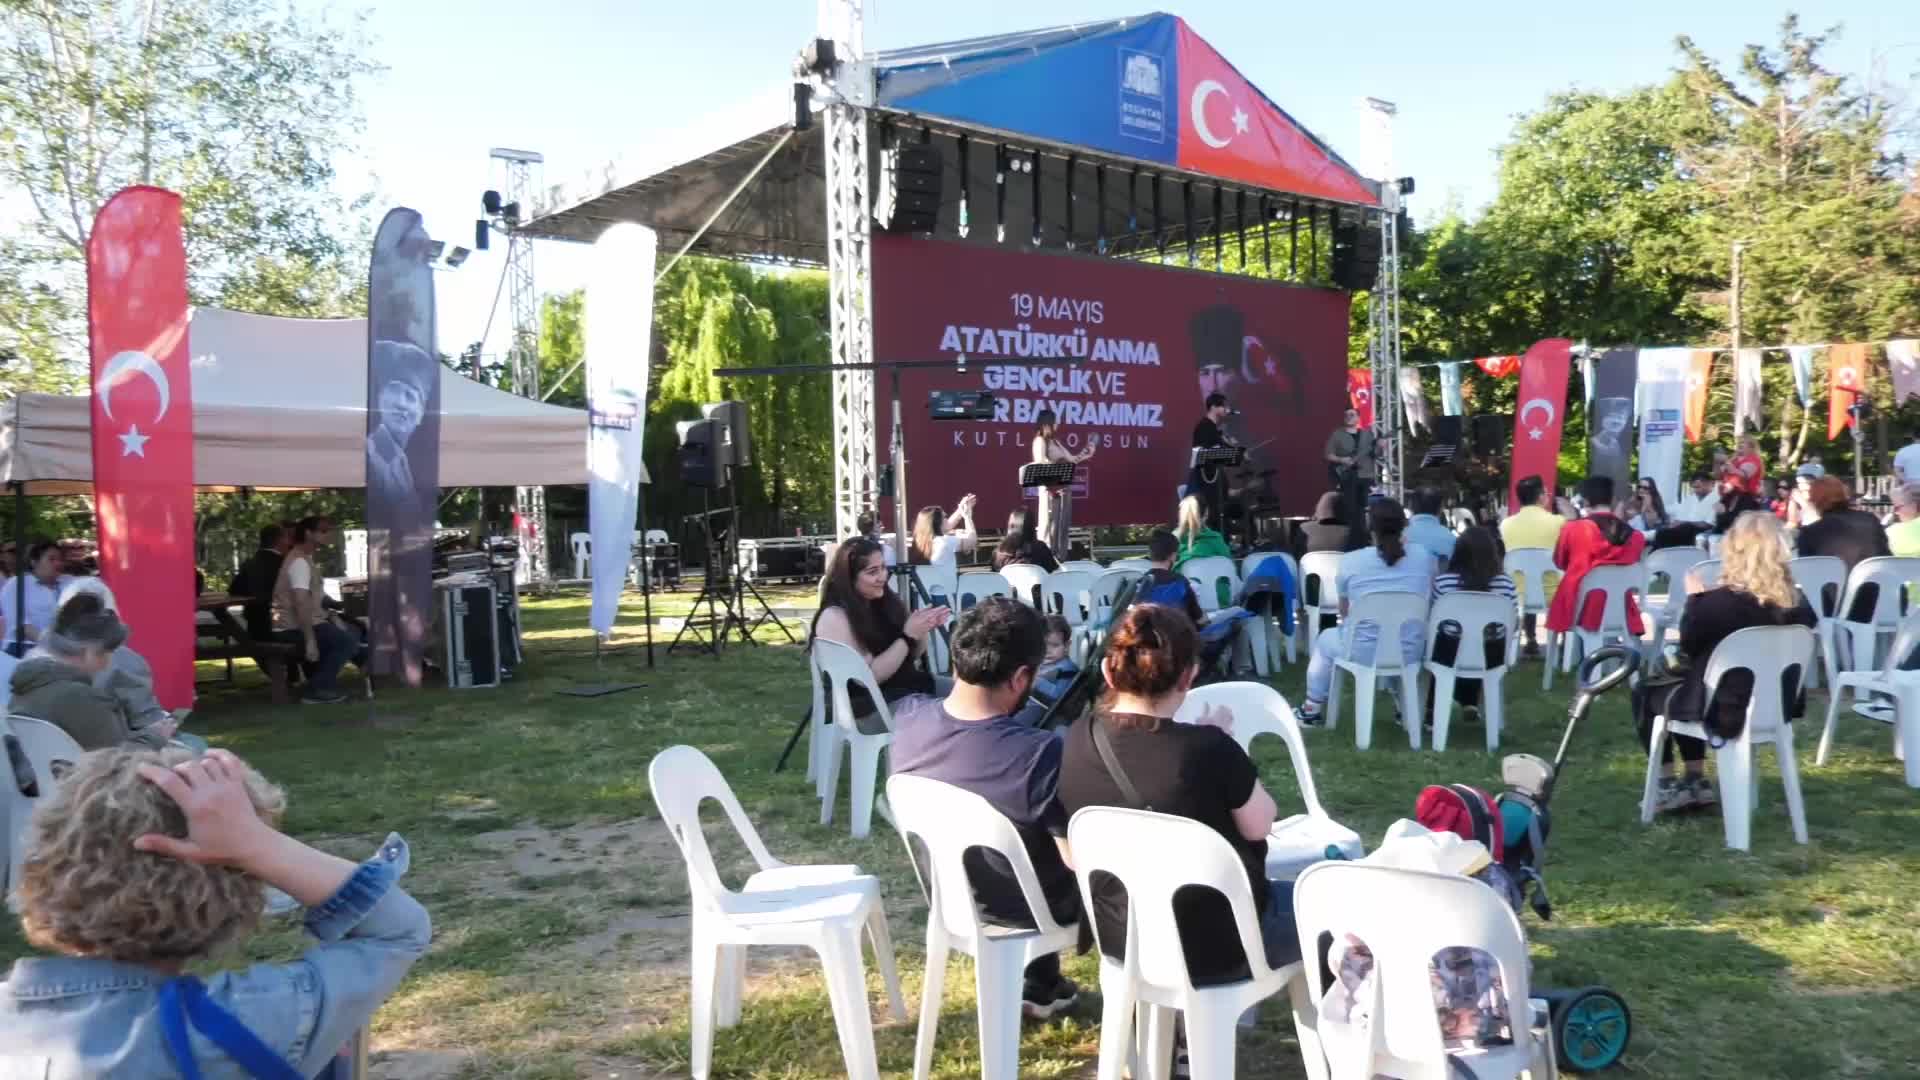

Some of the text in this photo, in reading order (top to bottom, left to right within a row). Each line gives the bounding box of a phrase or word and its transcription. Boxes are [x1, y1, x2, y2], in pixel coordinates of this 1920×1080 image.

[1009, 293, 1104, 323] 19 MAYIS
[940, 323, 1161, 365] ATATÜRK'Ü ANMA
[984, 364, 1126, 397] GENÇLİK VE
[953, 431, 1148, 448] KUTL OSUN
